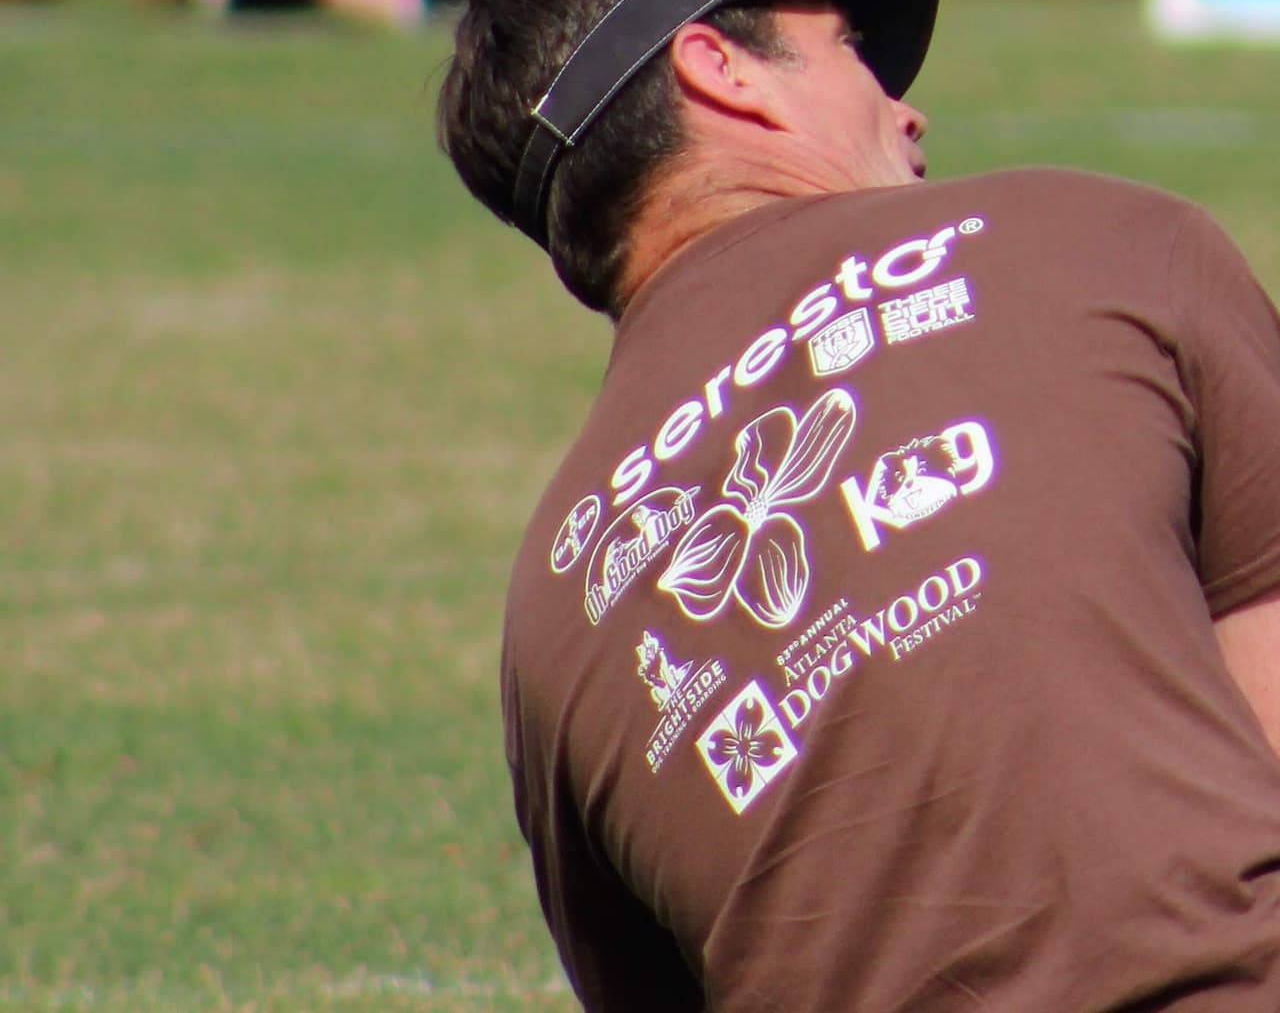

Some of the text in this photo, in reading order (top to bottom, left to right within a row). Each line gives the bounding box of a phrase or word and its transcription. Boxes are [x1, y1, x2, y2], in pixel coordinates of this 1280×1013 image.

[877, 277, 966, 313] THREE
[880, 289, 970, 324] PIECE
[882, 297, 971, 337] SUIT
[886, 313, 975, 345] FOOTBALL
[606, 528, 653, 595] Good
[653, 486, 702, 545] Dog
[798, 598, 849, 647] ANNUAL
[782, 614, 859, 687] ATLANTA
[645, 659, 724, 766] BRIGHTSIDE
[665, 689, 684, 714] THE
[691, 673, 728, 714] BOARDING
